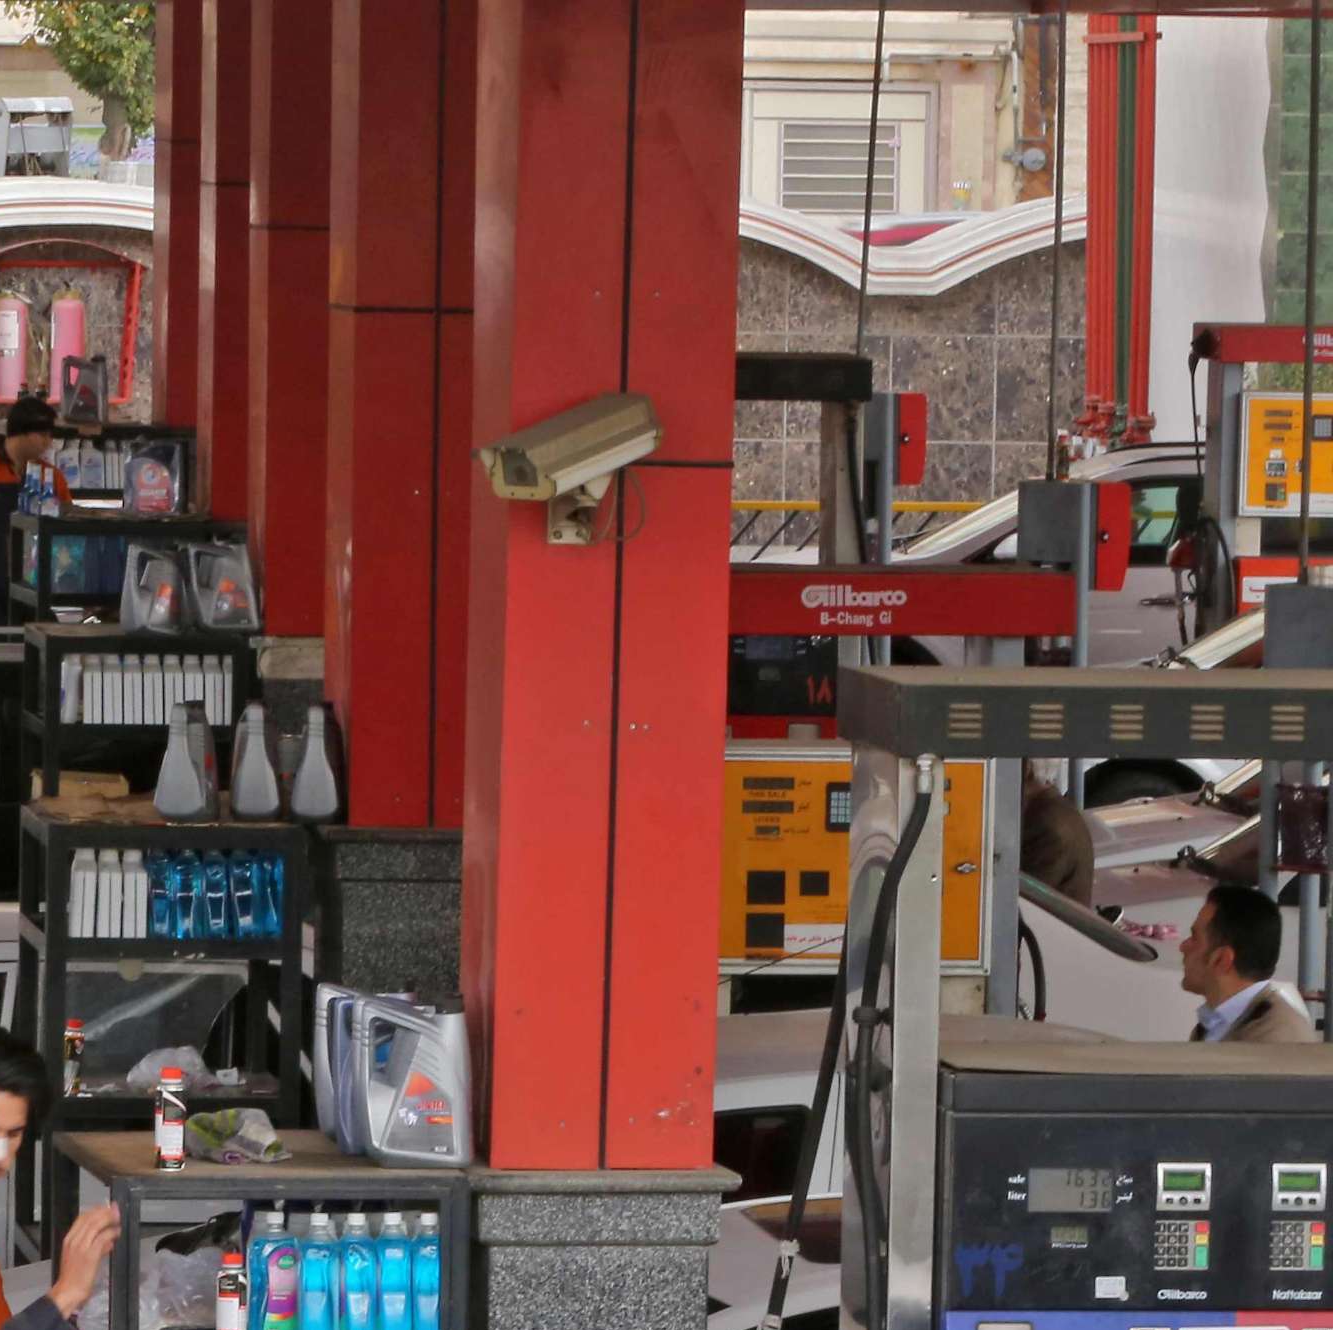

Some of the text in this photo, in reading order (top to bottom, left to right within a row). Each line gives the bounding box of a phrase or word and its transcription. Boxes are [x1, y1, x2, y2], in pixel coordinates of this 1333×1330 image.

[801, 585, 908, 609] Gilbarco
[820, 610, 891, 628] B-Chang Gi
[1007, 1190, 1027, 1201] liter
